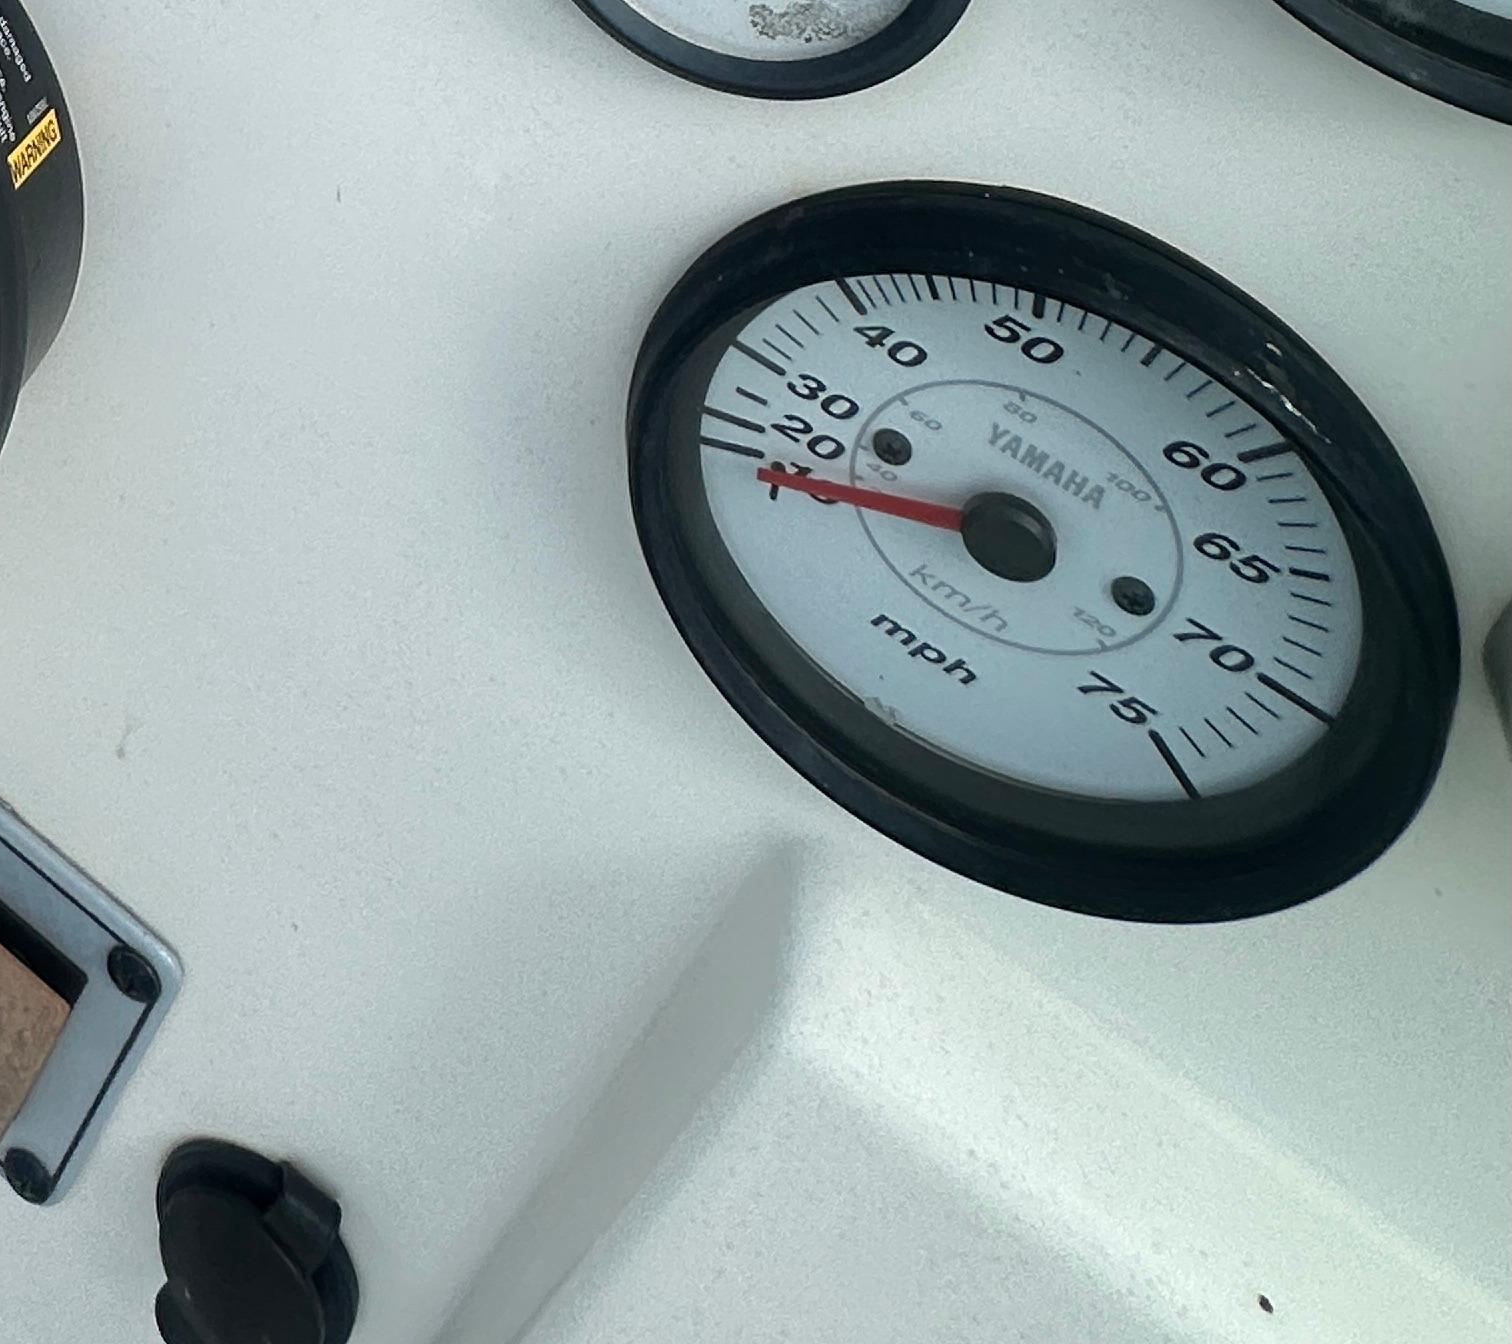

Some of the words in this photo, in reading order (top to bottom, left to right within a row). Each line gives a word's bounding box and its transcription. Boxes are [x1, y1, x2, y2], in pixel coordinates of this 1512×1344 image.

[10, 115, 58, 184] WARNING
[853, 325, 928, 368] 40
[984, 314, 1064, 364] 50
[787, 373, 860, 420] 30
[771, 414, 846, 460] 20
[985, 422, 1107, 510] YAMAHA
[1105, 472, 1152, 503] 100
[1162, 440, 1248, 491] 60
[1193, 532, 1281, 584] 65
[909, 564, 1010, 633] km/h
[1073, 606, 1117, 638] 120
[870, 613, 979, 686] mph
[1173, 617, 1256, 673] 70
[1077, 670, 1158, 726] 75
